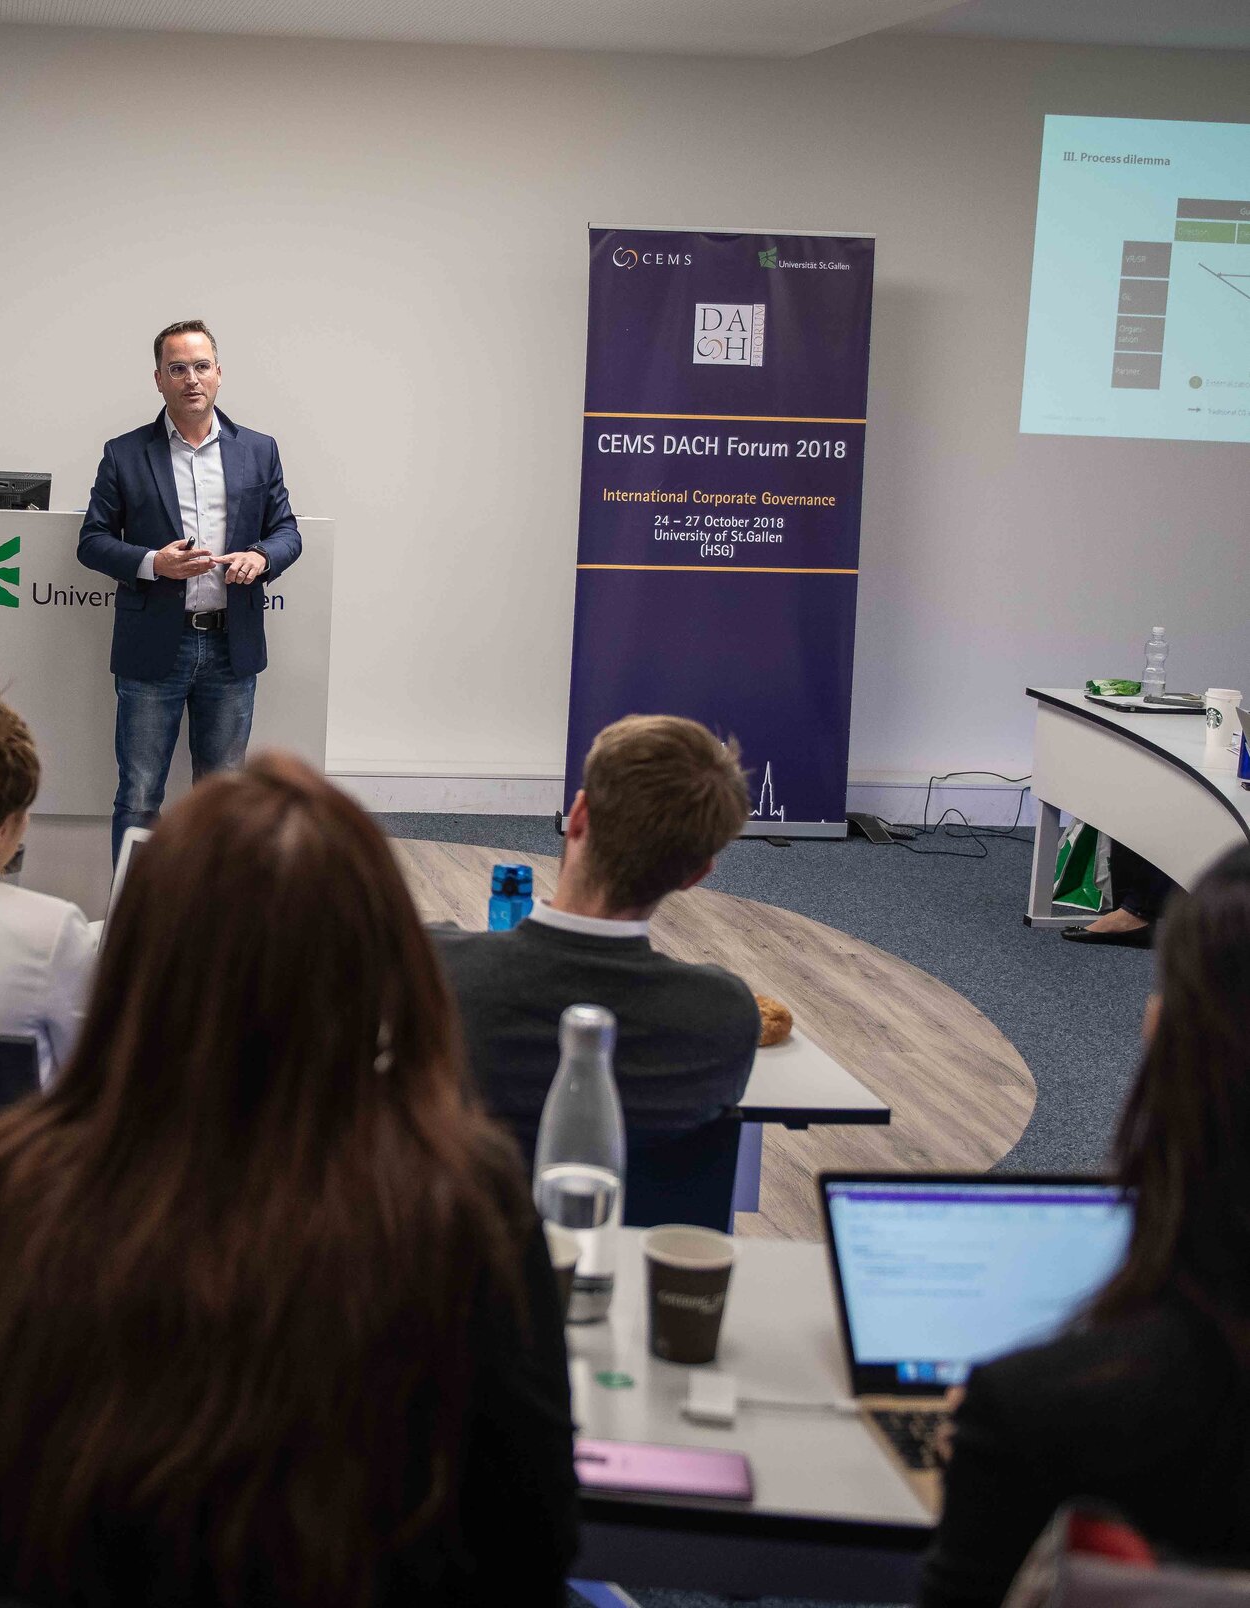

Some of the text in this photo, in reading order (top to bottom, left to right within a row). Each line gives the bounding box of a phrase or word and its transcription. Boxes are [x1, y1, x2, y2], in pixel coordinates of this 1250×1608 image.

[1063, 151, 1171, 166] III. Process dilemma
[642, 253, 692, 266] CEMS
[778, 260, 850, 271] Universität St.Gallen
[597, 433, 847, 459] CEMS DACH Forum 2018
[603, 488, 836, 507] International Corporate Governance
[654, 515, 670, 526] 24
[685, 516, 700, 527] 27
[704, 515, 750, 528] October
[753, 517, 784, 529] 2018
[654, 529, 783, 545] University of St.Gallen
[700, 543, 734, 558] (HSG)
